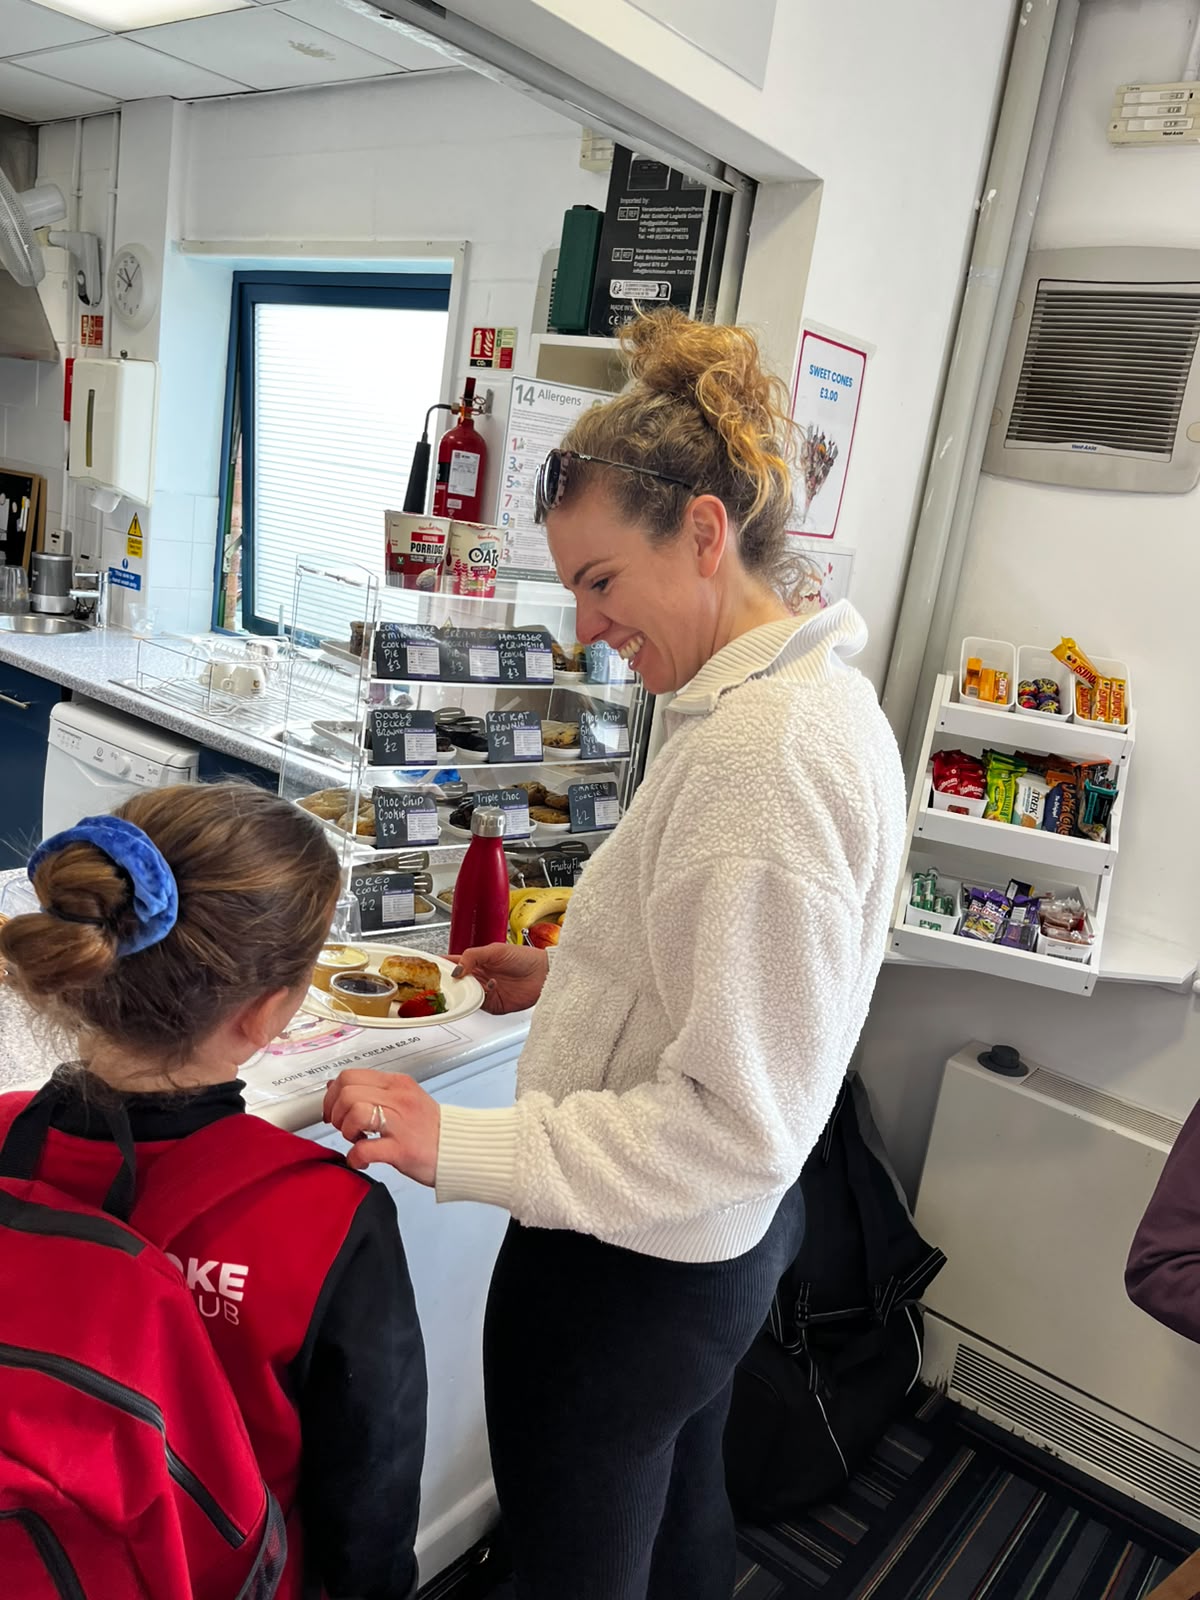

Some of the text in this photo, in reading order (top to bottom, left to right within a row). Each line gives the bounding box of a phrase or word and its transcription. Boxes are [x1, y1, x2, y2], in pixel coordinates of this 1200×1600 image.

[809, 364, 853, 387] SWEET CONES
[516, 384, 582, 406] 14 Allergens
[820, 387, 838, 402] £3.00
[512, 438, 518, 451] 1
[509, 456, 516, 470] 3
[506, 475, 514, 488] 5
[505, 494, 513, 507] 7
[502, 513, 510, 525] 9
[410, 542, 444, 555] PORRIDGE
[468, 548, 499, 567] OATS
[384, 649, 399, 658] PIE
[387, 658, 400, 672] £3
[451, 660, 463, 675] £3
[507, 668, 519, 679] £3
[488, 712, 530, 722] KIT KAT
[581, 713, 598, 725] Choc
[375, 720, 412, 728] DECKER
[384, 738, 398, 753] £2
[494, 734, 510, 748] £2
[377, 795, 400, 808] Choc
[476, 791, 521, 803] Triple Choc
[574, 791, 601, 802] COOKIE
[1030, 790, 1041, 815] TREK
[378, 808, 406, 821] Cookie
[575, 809, 590, 824] £2
[382, 823, 397, 836] £2
[550, 861, 572, 875] Fruity
[355, 877, 390, 886] OREO
[356, 884, 389, 895] COOKIE
[360, 897, 376, 911] £2
[271, 1072, 305, 1087] SCONE
[305, 1064, 330, 1077] WITH
[332, 1058, 353, 1069] JAM
[362, 1044, 394, 1058] CREAM
[395, 1035, 421, 1049] £2.50
[164, 1252, 249, 1302] KE
[199, 1294, 239, 1325] UB
